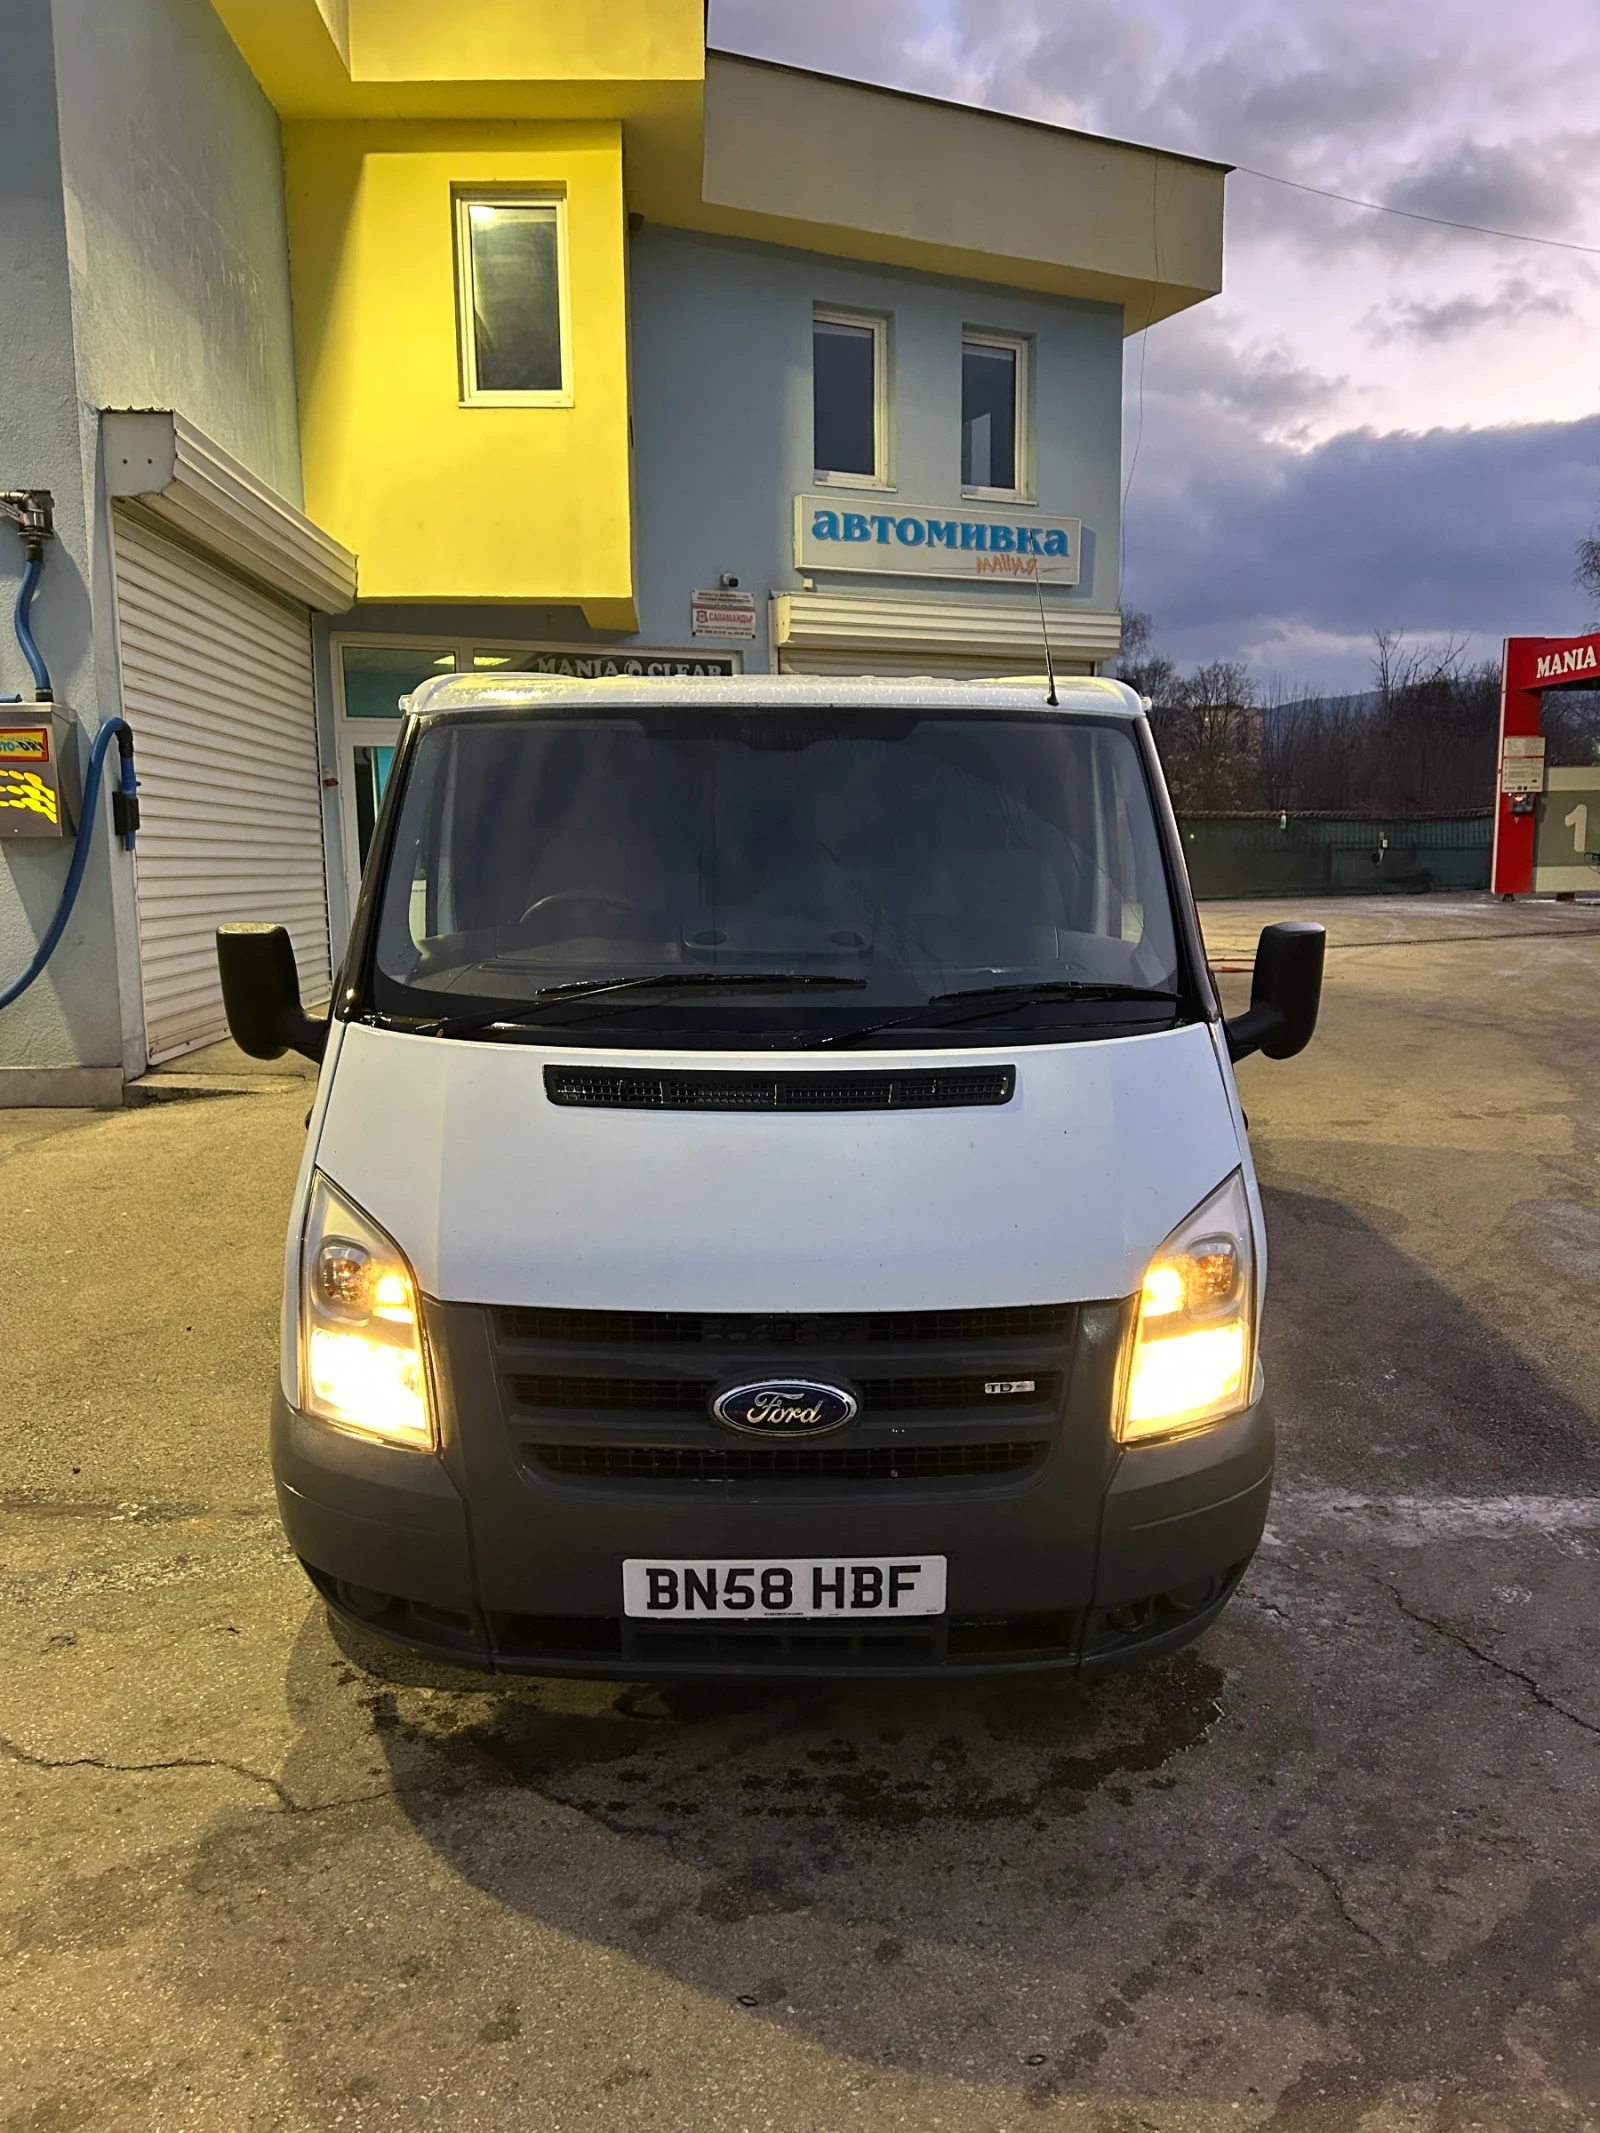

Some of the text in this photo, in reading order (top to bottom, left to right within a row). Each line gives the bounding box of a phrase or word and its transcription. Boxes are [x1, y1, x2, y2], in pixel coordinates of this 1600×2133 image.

[811, 510, 1070, 557] автомивка
[709, 612, 754, 624] САЛАМАНДЪР
[537, 658, 619, 677] MANIA
[1536, 645, 1597, 679] MANIA
[0, 741, 46, 752] TO-DRY
[1565, 804, 1588, 853] 1
[746, 1391, 823, 1424] Ford
[645, 1564, 922, 1611] BN58 HBF
